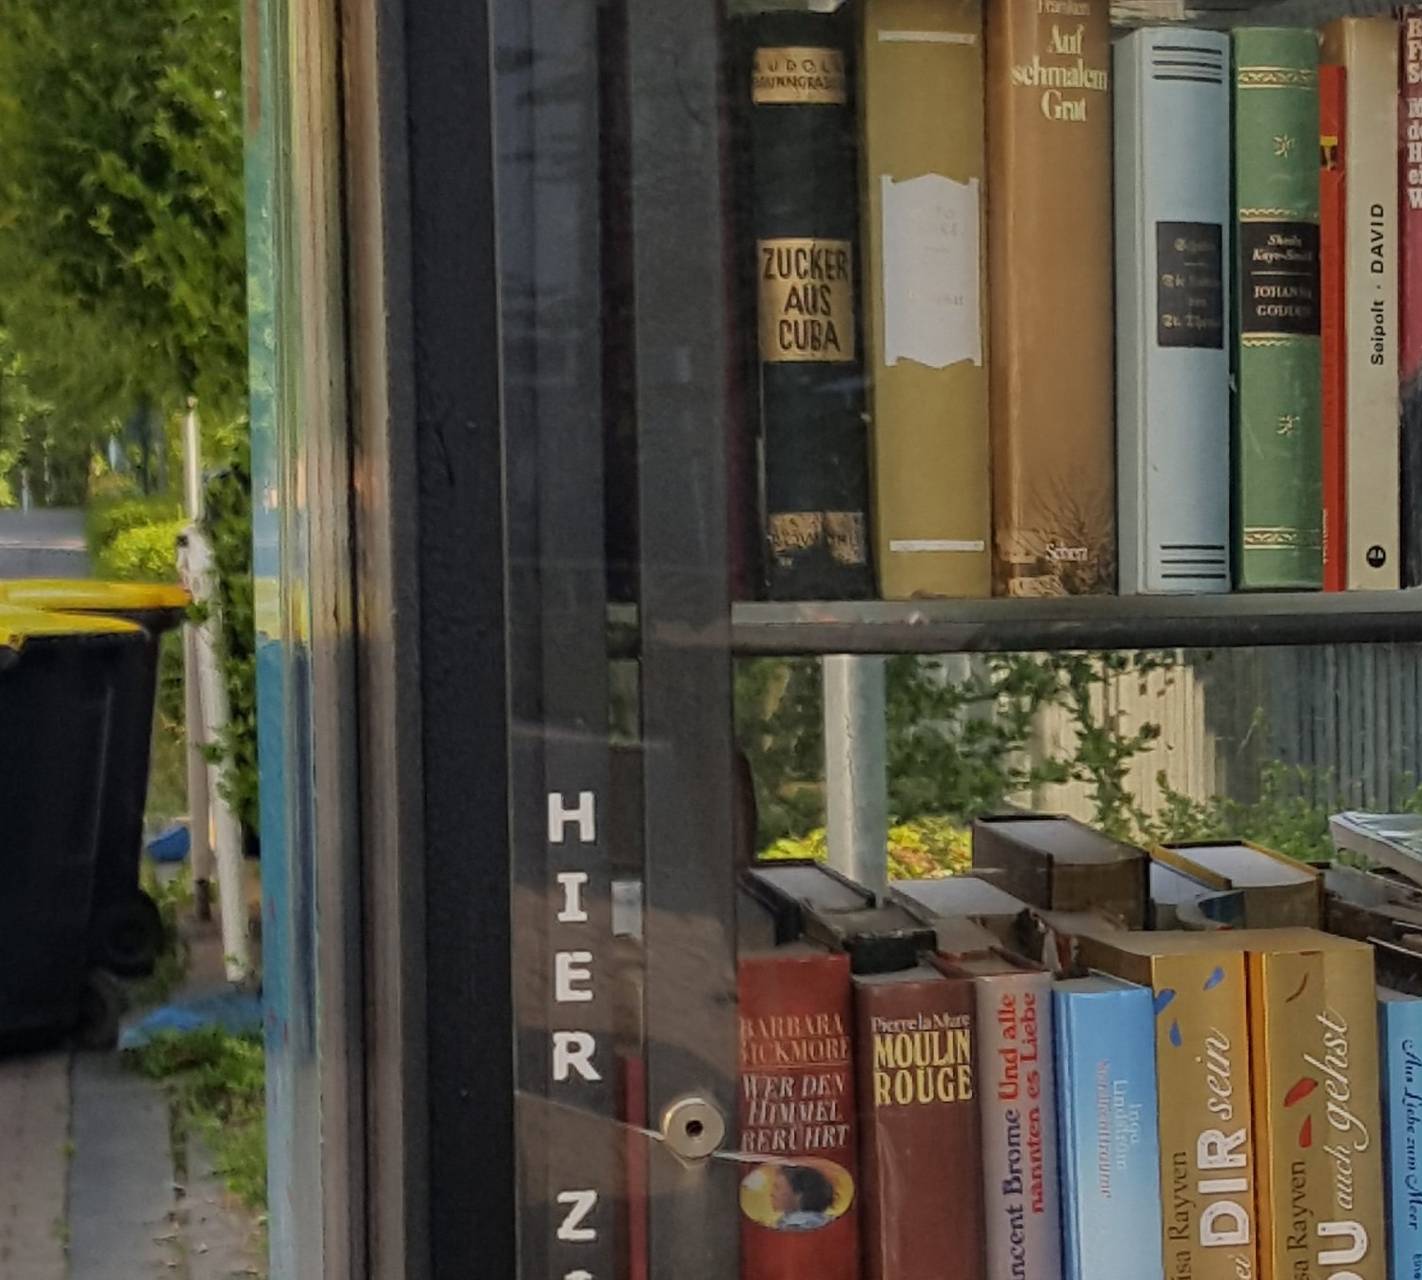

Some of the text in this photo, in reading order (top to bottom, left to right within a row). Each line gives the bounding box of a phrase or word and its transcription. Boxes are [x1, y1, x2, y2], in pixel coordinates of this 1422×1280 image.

[1047, 24, 1085, 54] Auf
[757, 58, 842, 73] UDOL
[1010, 55, 1107, 91] schmalem
[1041, 89, 1086, 122] Grat
[763, 247, 848, 280] ZUCKER
[784, 283, 832, 316] AUS
[1370, 203, 1385, 366] Seipolt DAVID
[778, 319, 841, 352] CUBA
[547, 792, 600, 1280] HIER Z
[1021, 992, 1039, 1065] Liebe
[873, 1029, 970, 1070] MOULIN
[743, 1072, 845, 1100] WER DEN
[874, 1065, 973, 1106] ROUGE
[1025, 1070, 1041, 1097] es
[1196, 1027, 1233, 1120] sein
[1304, 1010, 1370, 1151] gehst
[748, 1099, 842, 1125] HIMMEL
[997, 992, 1026, 1280] ncent Brome Und alle
[1405, 1135, 1419, 1172] zum
[1168, 1151, 1196, 1240] Rayven
[1197, 1128, 1250, 1247] DIR
[1324, 1145, 1354, 1211] auch
[1287, 1161, 1314, 1251] Rayven
